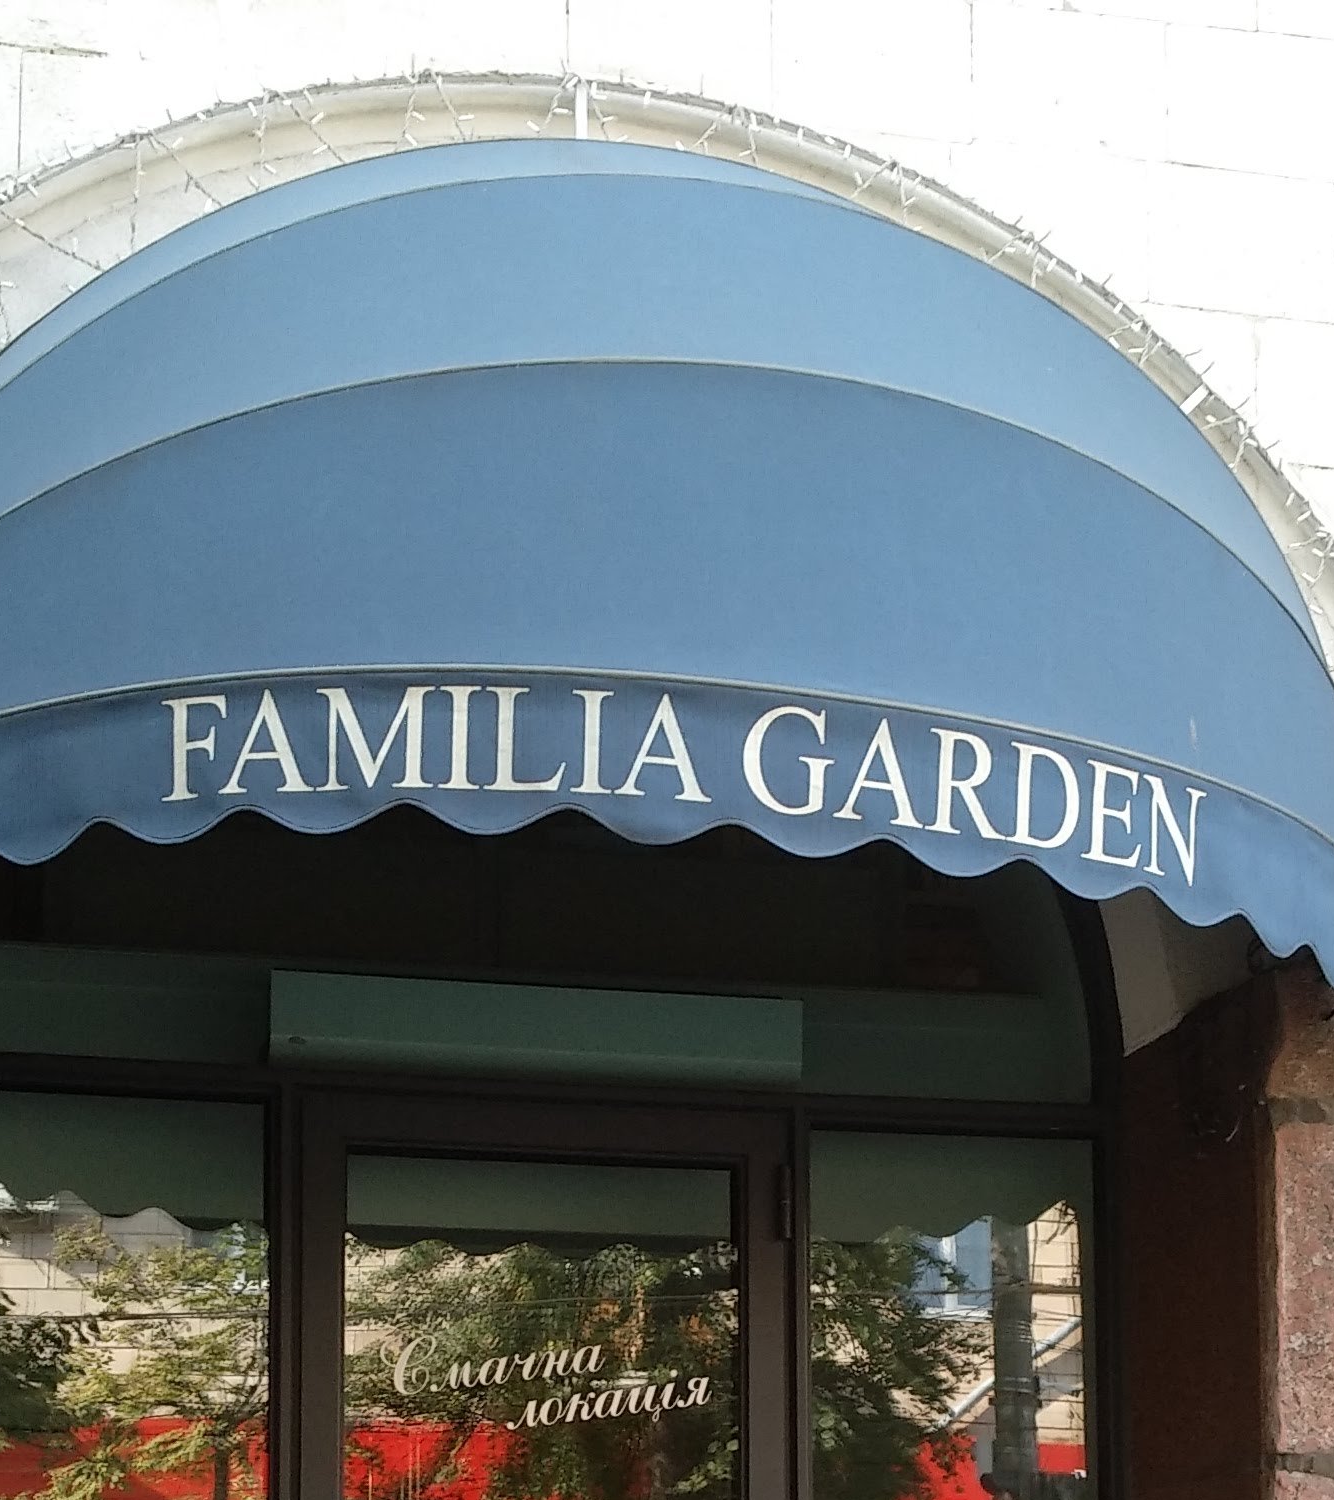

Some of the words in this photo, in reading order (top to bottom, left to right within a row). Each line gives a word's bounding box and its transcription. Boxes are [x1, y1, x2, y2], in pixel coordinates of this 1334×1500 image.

[161, 685, 712, 803] FAMILIA
[742, 705, 1207, 887] GARDEN
[379, 1334, 607, 1396] Смачна
[507, 1370, 712, 1430] локація
